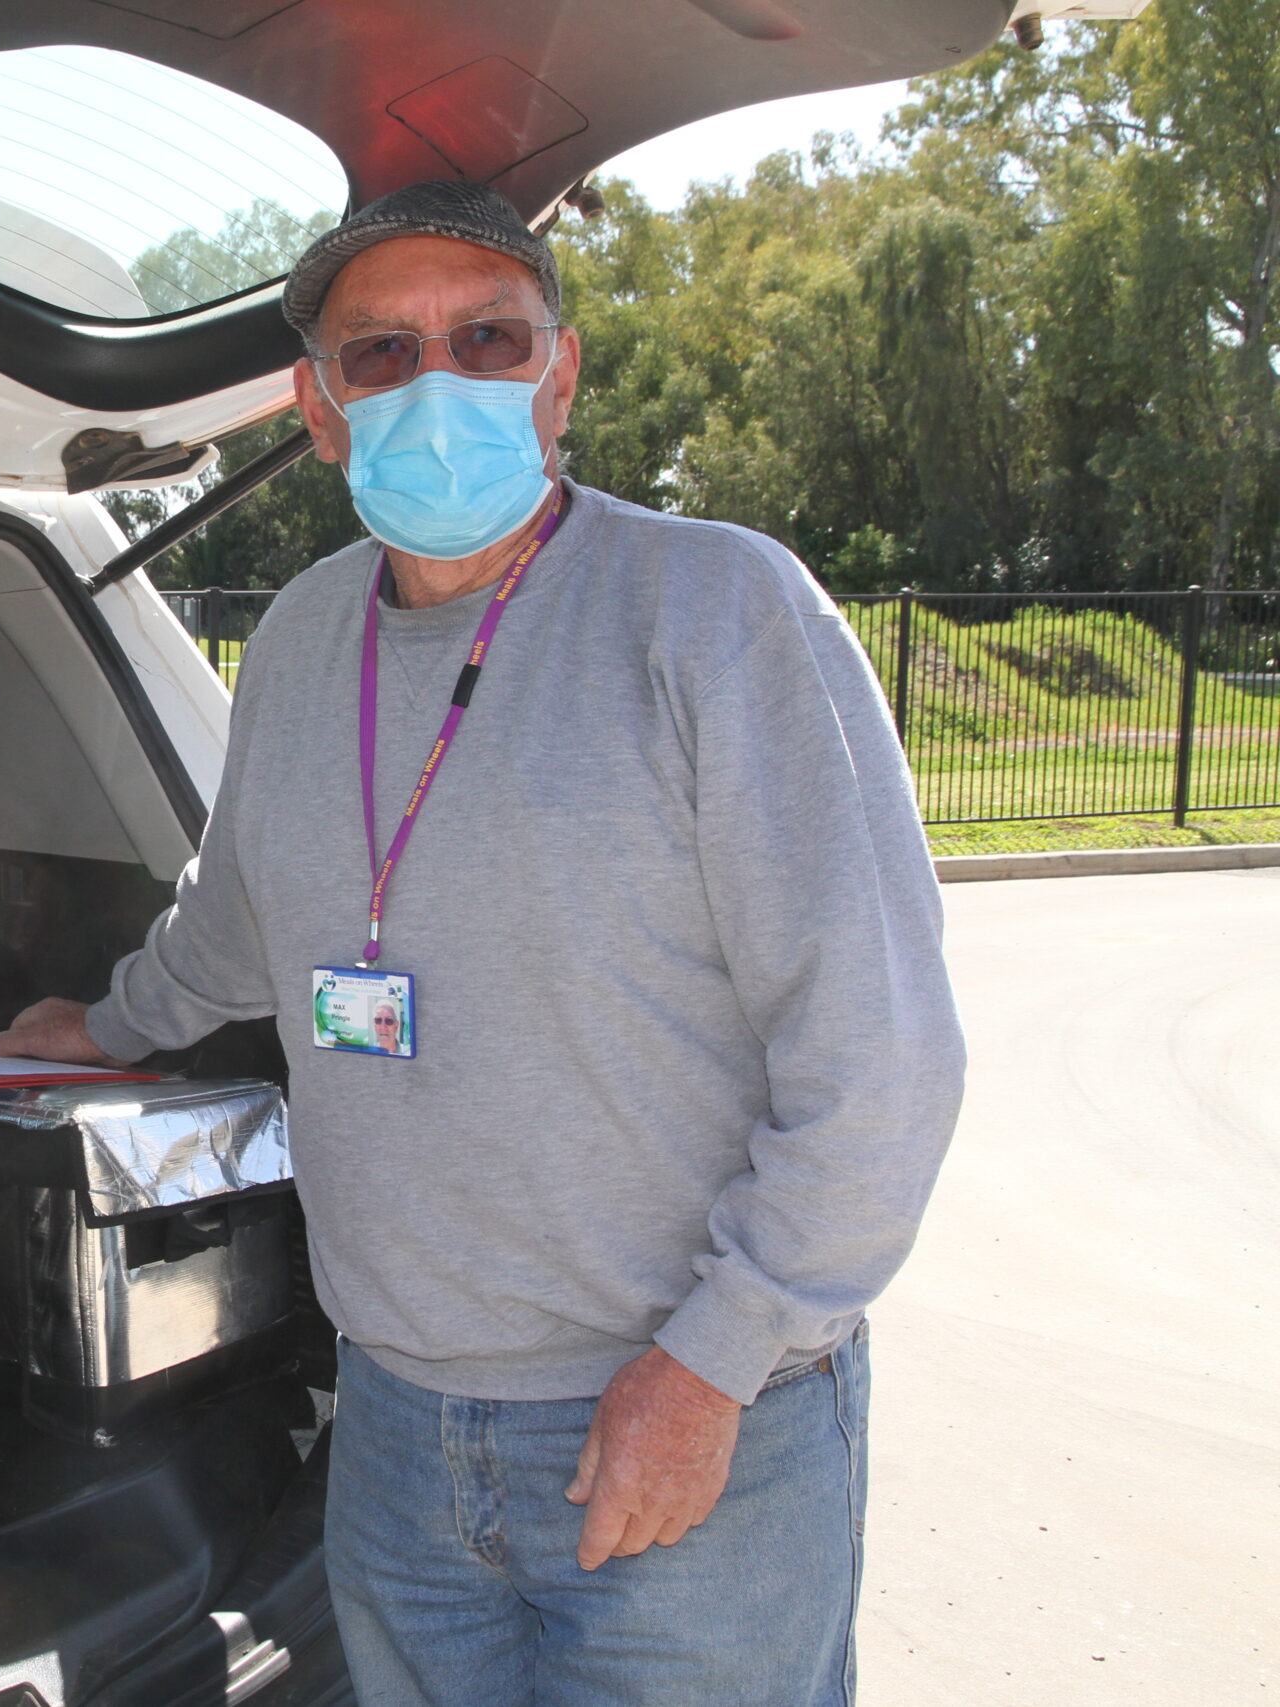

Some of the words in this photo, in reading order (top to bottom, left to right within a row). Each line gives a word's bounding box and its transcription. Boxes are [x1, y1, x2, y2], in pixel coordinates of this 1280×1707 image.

[517, 539, 542, 566] Wheels
[512, 565, 524, 577] on
[496, 577, 517, 601] Meals
[470, 641, 485, 666] heels
[406, 789, 422, 817] Meals
[419, 774, 429, 787] on
[424, 739, 446, 773] Wheels
[374, 859, 393, 895] Wheels
[372, 896, 380, 910] on
